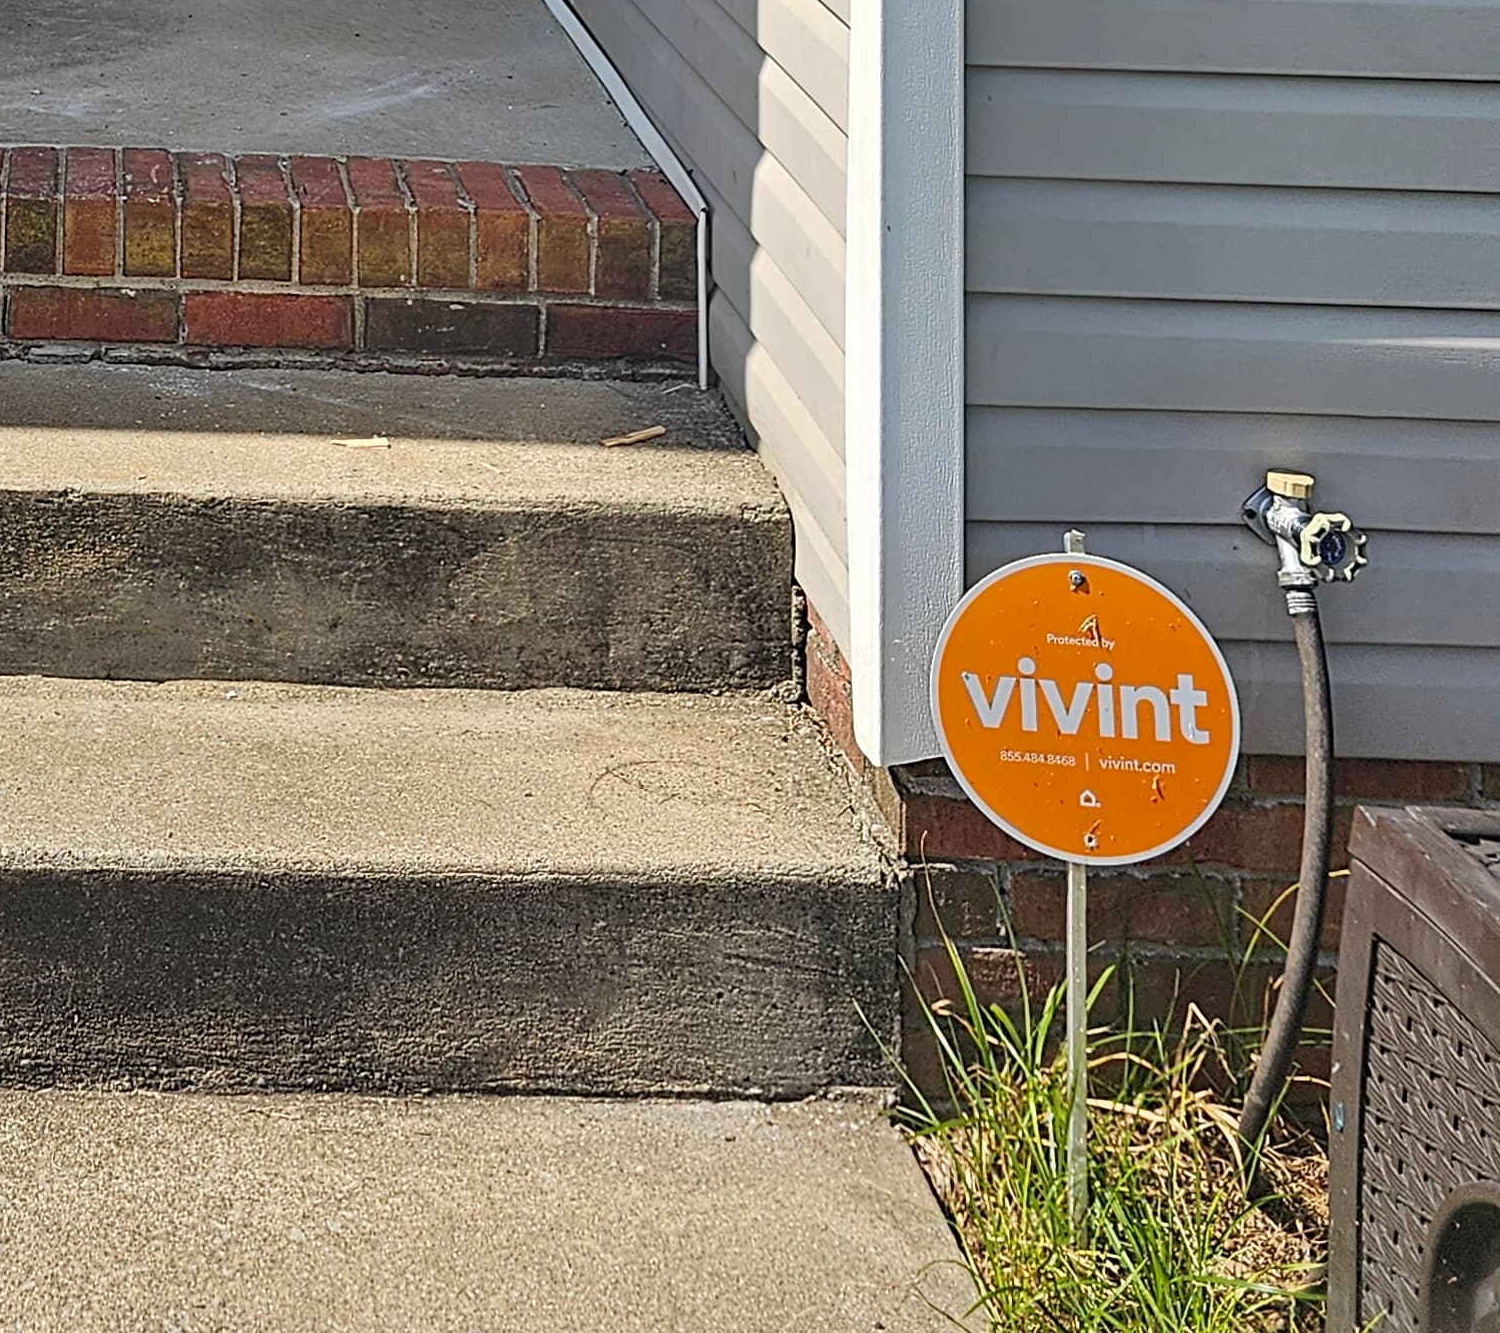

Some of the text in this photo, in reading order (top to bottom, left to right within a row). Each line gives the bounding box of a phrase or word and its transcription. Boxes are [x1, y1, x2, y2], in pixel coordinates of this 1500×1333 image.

[1046, 633, 1115, 651] Protected by
[961, 656, 1211, 745] vivint
[1000, 750, 1176, 774] 855.484.8468 vivint.com
